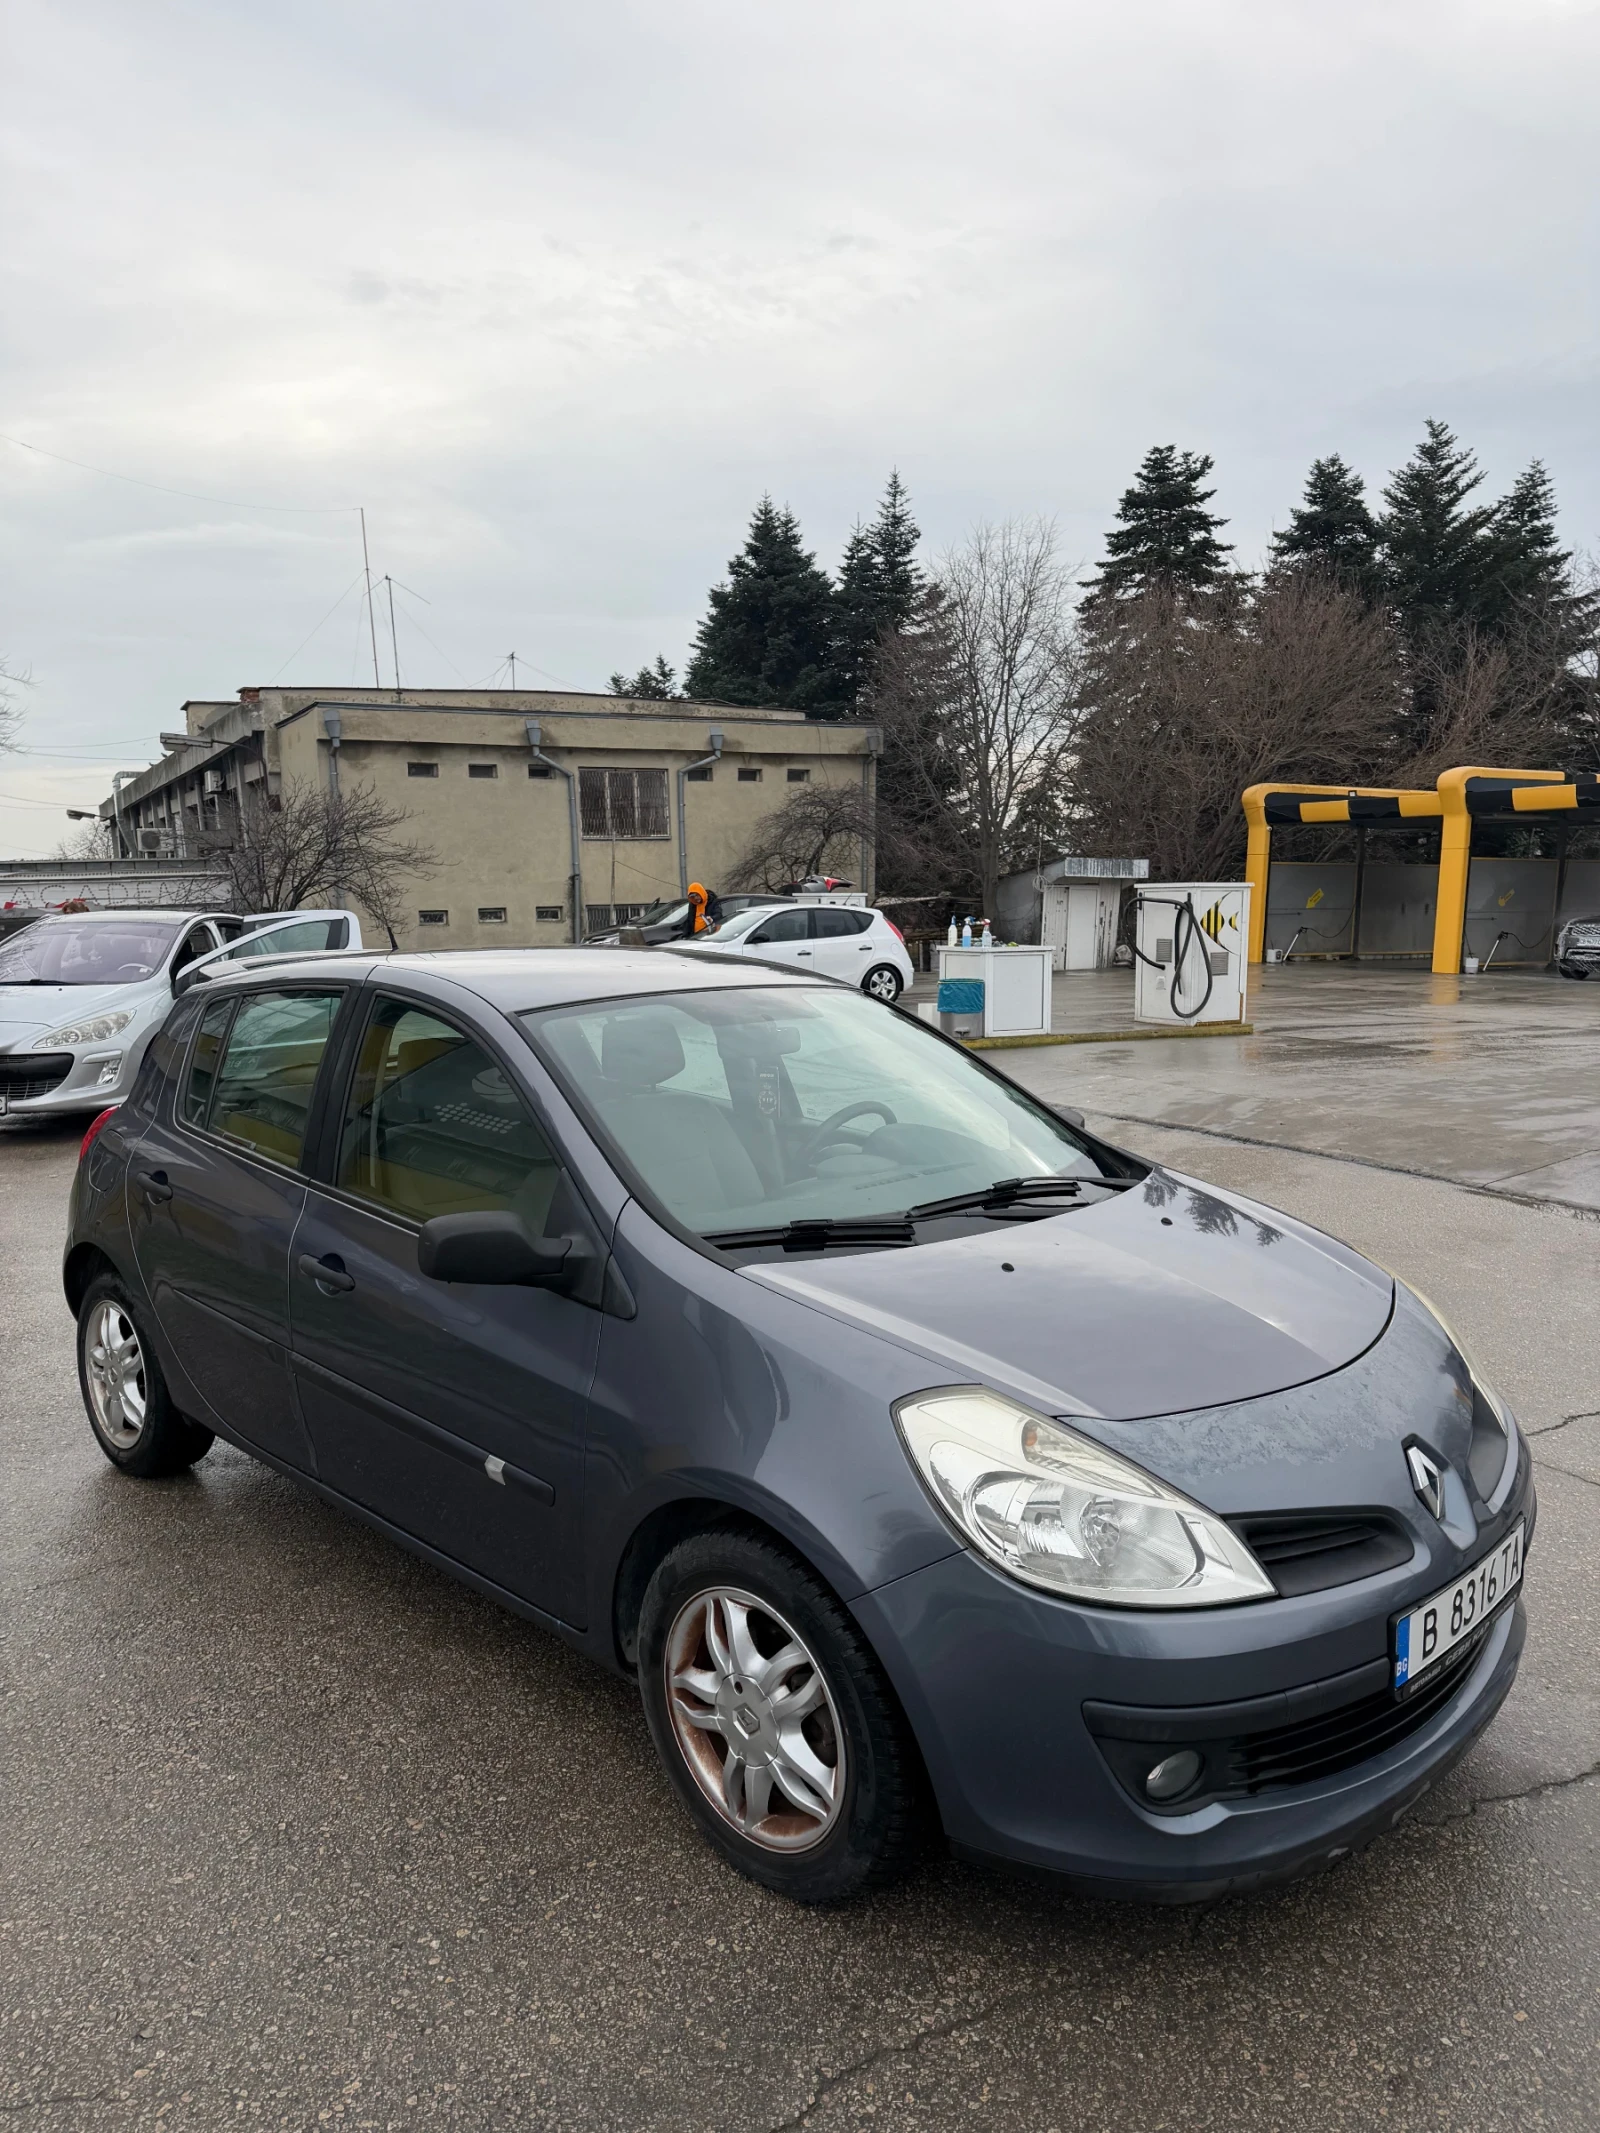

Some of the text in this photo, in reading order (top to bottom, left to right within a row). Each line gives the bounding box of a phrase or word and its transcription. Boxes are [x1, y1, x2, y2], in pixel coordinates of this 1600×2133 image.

[1422, 1607, 1438, 1661] B
[1450, 1557, 1497, 1637] 8316
[1501, 1535, 1519, 1591] TA
[1396, 1657, 1408, 1678] BG
